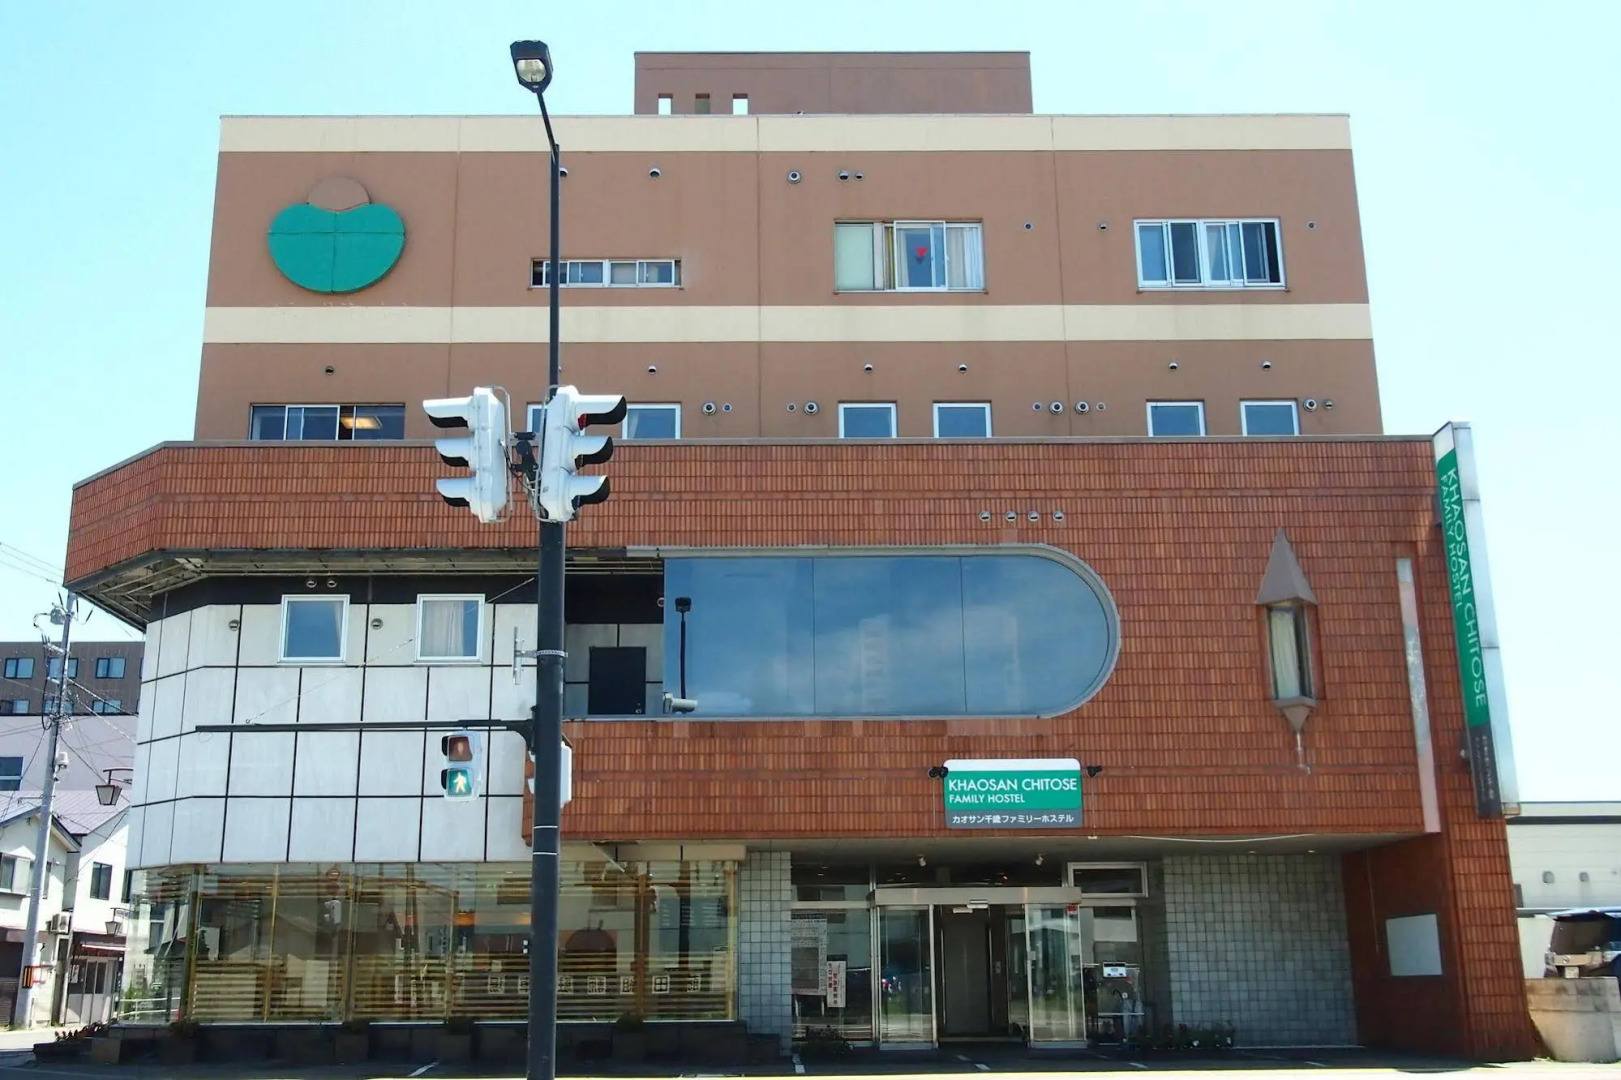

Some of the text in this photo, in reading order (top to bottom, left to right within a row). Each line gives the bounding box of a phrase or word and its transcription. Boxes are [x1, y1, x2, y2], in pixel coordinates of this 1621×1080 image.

[1441, 475, 1463, 609] FAMILY HOSTEL
[1448, 467, 1487, 708] KHAOSAN CHITOSE
[948, 778, 1077, 792] KHAOSAN CHITOSE
[949, 793, 1025, 803] FAMILY HOSTEL
